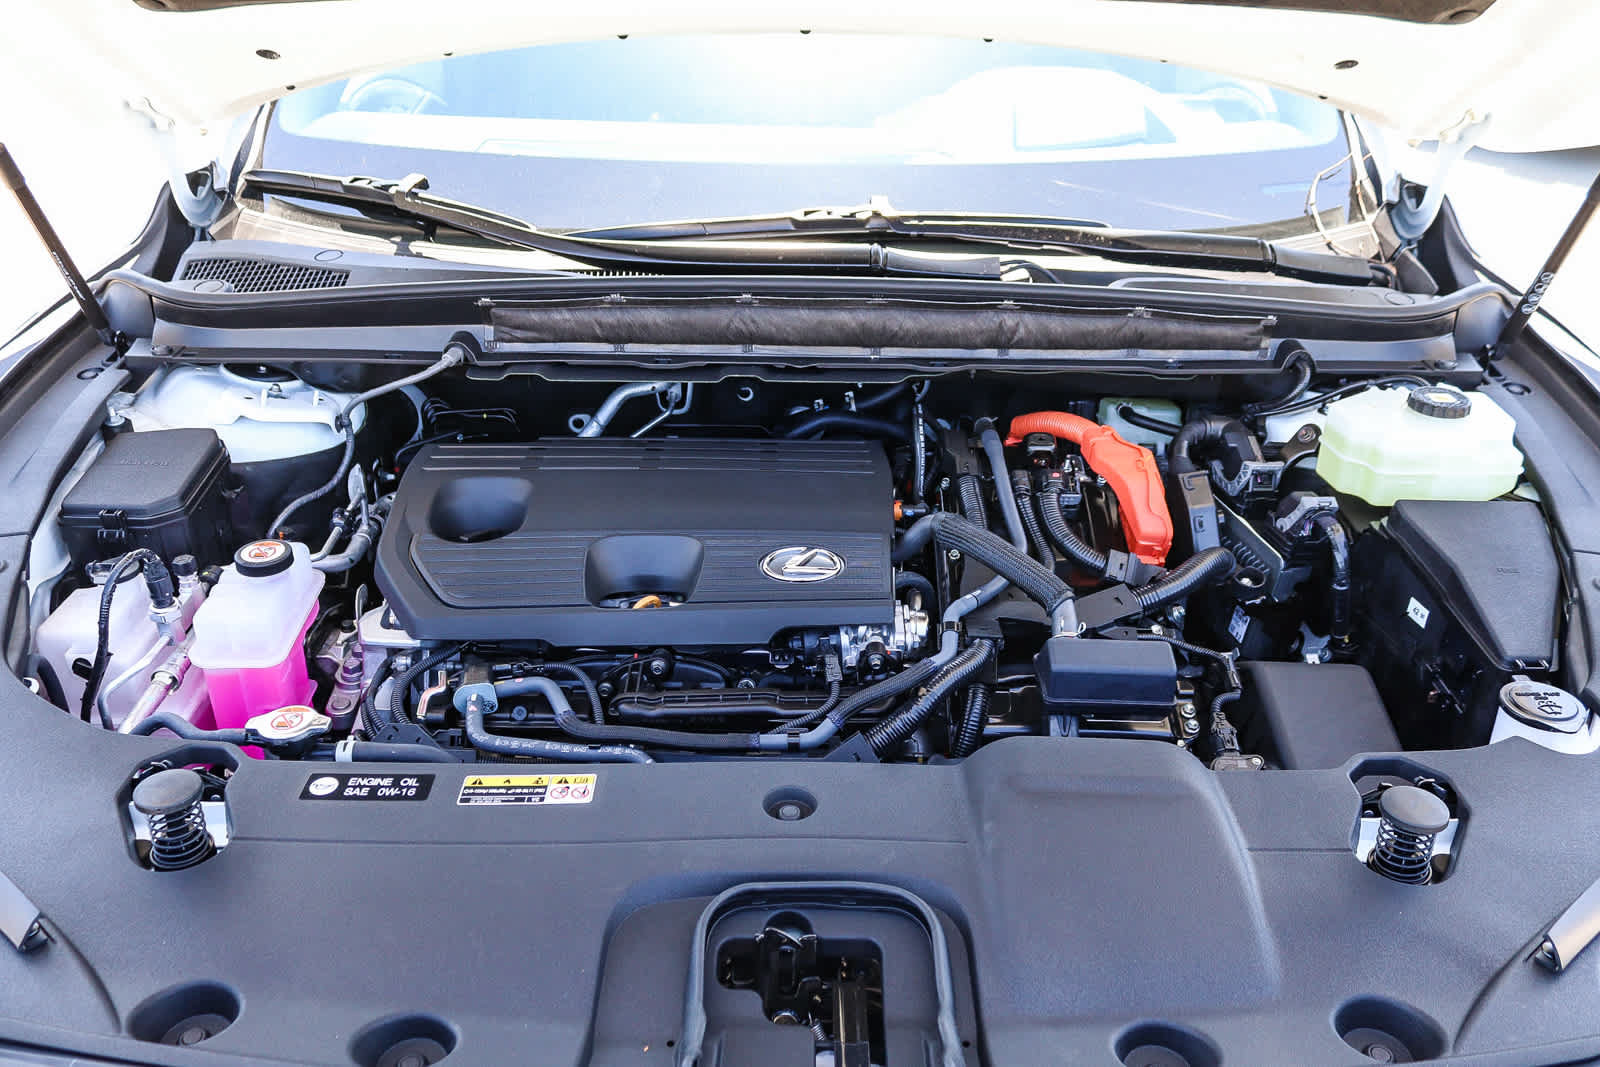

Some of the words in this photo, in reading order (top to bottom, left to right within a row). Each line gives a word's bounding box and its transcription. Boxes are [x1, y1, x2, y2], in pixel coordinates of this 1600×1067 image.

[347, 777, 394, 786] ENGINE
[399, 777, 420, 786] OIL
[343, 787, 370, 796] SAE
[377, 787, 417, 796] 0W-16
